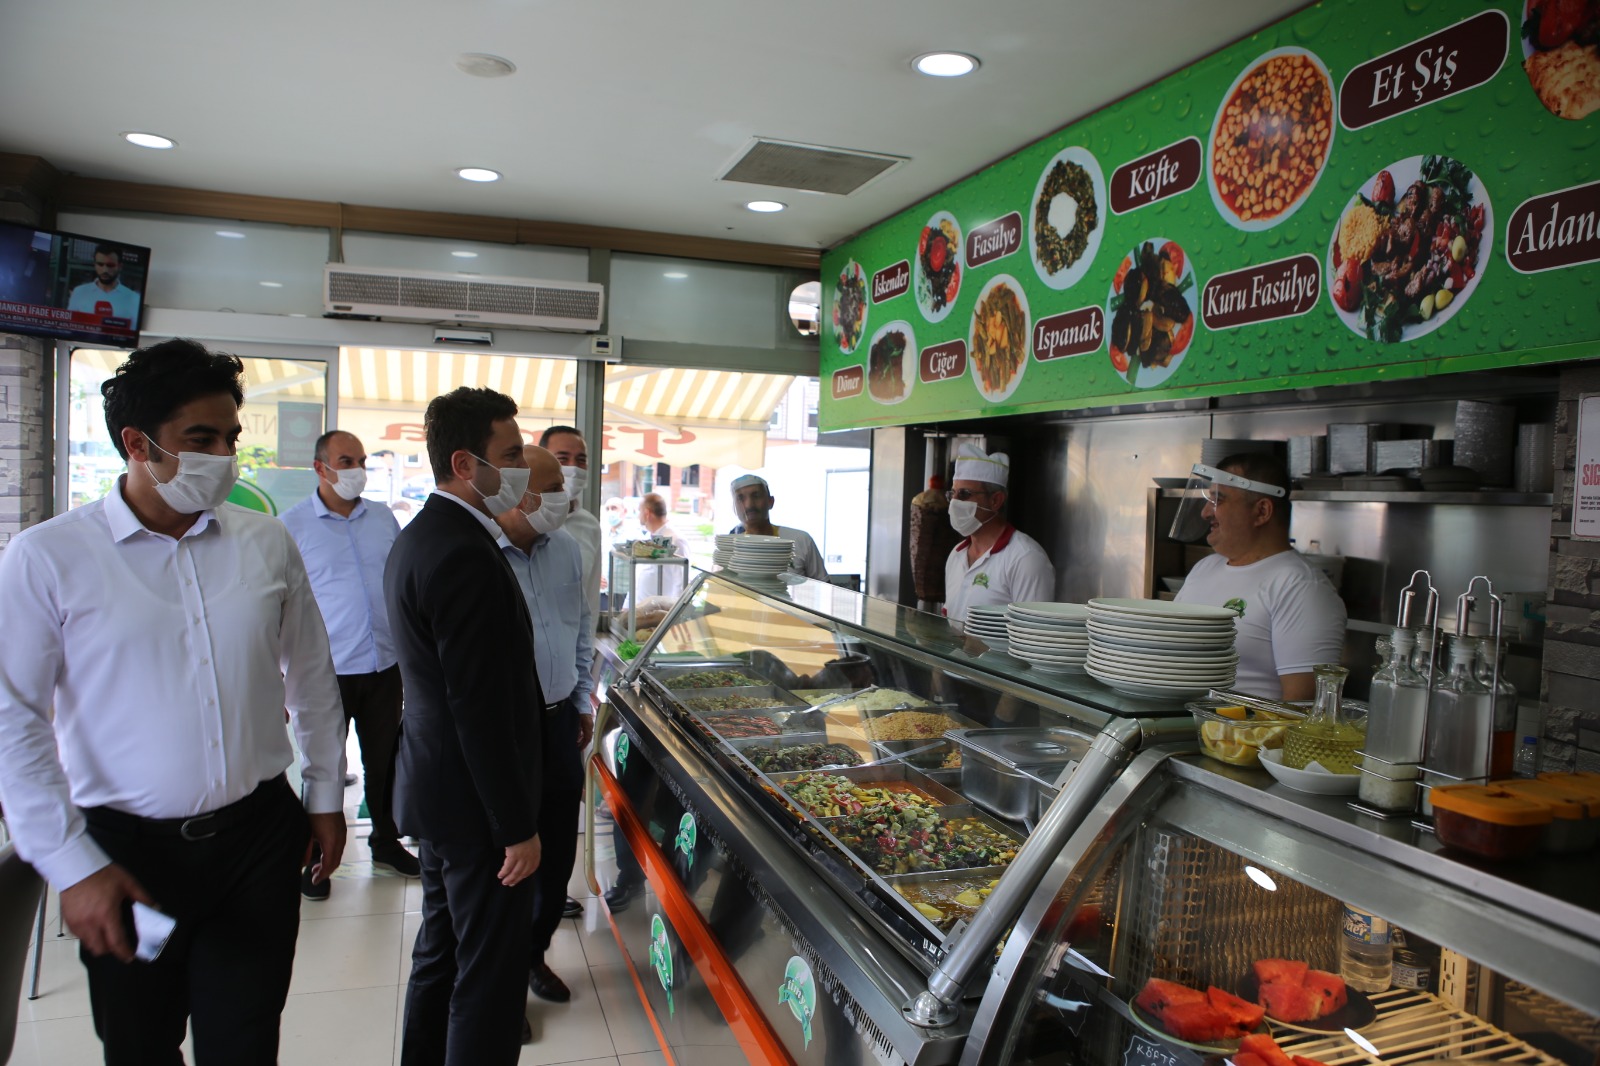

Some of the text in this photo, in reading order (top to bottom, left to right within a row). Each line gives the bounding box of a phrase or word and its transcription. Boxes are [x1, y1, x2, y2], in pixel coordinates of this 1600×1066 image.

[1368, 45, 1458, 108] Et Şiş
[1127, 154, 1180, 201] Köfte
[972, 224, 1017, 260] Fasülye
[873, 268, 909, 298] İskender
[1206, 263, 1316, 317] Kuru Fasülye
[28, 304, 49, 317] İFADE
[51, 308, 72, 320] VERDİ
[1036, 311, 1101, 357] Ispanak
[929, 351, 958, 379] Ciğer
[836, 374, 860, 393] Döner
